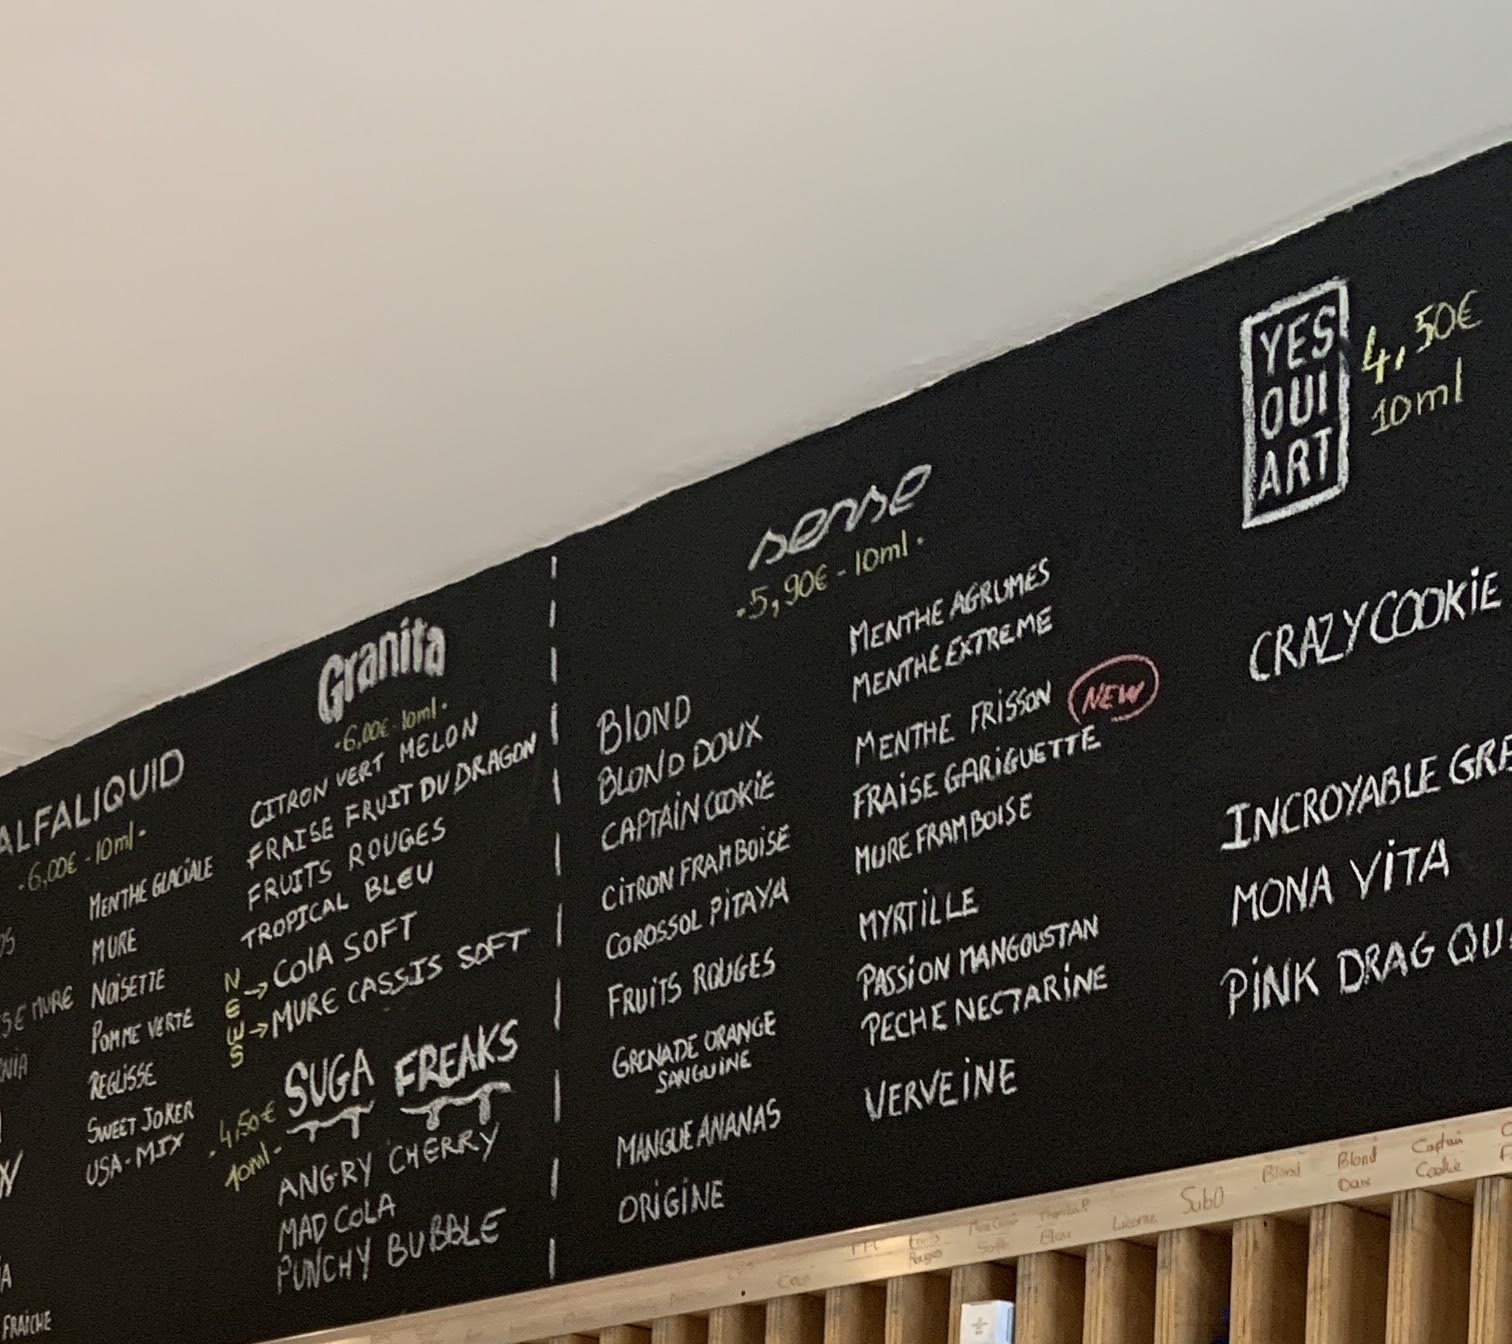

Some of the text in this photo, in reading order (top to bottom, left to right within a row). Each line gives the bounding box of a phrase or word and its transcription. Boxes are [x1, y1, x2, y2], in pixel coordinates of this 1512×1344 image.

[1260, 306, 1336, 375] YES
[1361, 290, 1482, 384] 4,50€
[1260, 371, 1327, 439] OUI
[1258, 428, 1332, 500] ART
[849, 558, 1051, 656] MENTHE AGRUMES
[1249, 566, 1502, 682] CRAZY COOKIE
[317, 617, 446, 724] Granita
[852, 606, 1054, 703] MENTHE EXTREME
[855, 681, 1052, 767] MENTHE FRISSON
[1081, 681, 1145, 714] NEW
[247, 731, 537, 870] FRAISE FRUIT DU DRAGON
[250, 711, 479, 829] CITRON VERT MELON
[598, 715, 764, 805] BLOND DOUX
[854, 794, 1033, 875] MURE FRAMBOISE
[1221, 755, 1441, 851] INCROYABLE
[89, 855, 214, 921] MENTHE GLACIALE
[241, 860, 433, 949] TROPICAL BLEU
[248, 817, 446, 912] FRUITS ROUGES
[601, 824, 790, 911] CITRON FRAMBOISE
[1232, 838, 1449, 927] MONA VITA
[92, 927, 138, 965] MURE
[605, 877, 788, 959] COROSSOL PITAYA
[859, 887, 979, 943] MYRTILLE
[91, 966, 166, 1009] NOISETTE
[271, 928, 531, 1039] MURE CASSIS SOFT
[608, 947, 776, 1020] FRUITS ROUGES
[856, 914, 1099, 1001] PASSION MANGOUSTAN
[1220, 955, 1319, 1020] PINK
[1336, 931, 1435, 995] DRAG
[91, 1008, 195, 1055] POMME VERTE
[612, 1010, 776, 1079] GRENADE ORANGE
[861, 962, 1109, 1046] PECHE NECTARINE
[89, 1061, 157, 1101] REGLISSE
[285, 1018, 519, 1117] SUGA FREAKS
[864, 1056, 1018, 1123] VERVEINE
[87, 1100, 195, 1144] SWEET JOKER
[278, 1121, 500, 1206] ANGRY CHERRY
[615, 1098, 782, 1169] MANGUE ANANAS
[618, 1177, 725, 1225] ORIGINE
[277, 1207, 506, 1294] PUNCHY BUBBLE
[1, 1310, 52, 1341] FRAICHE
